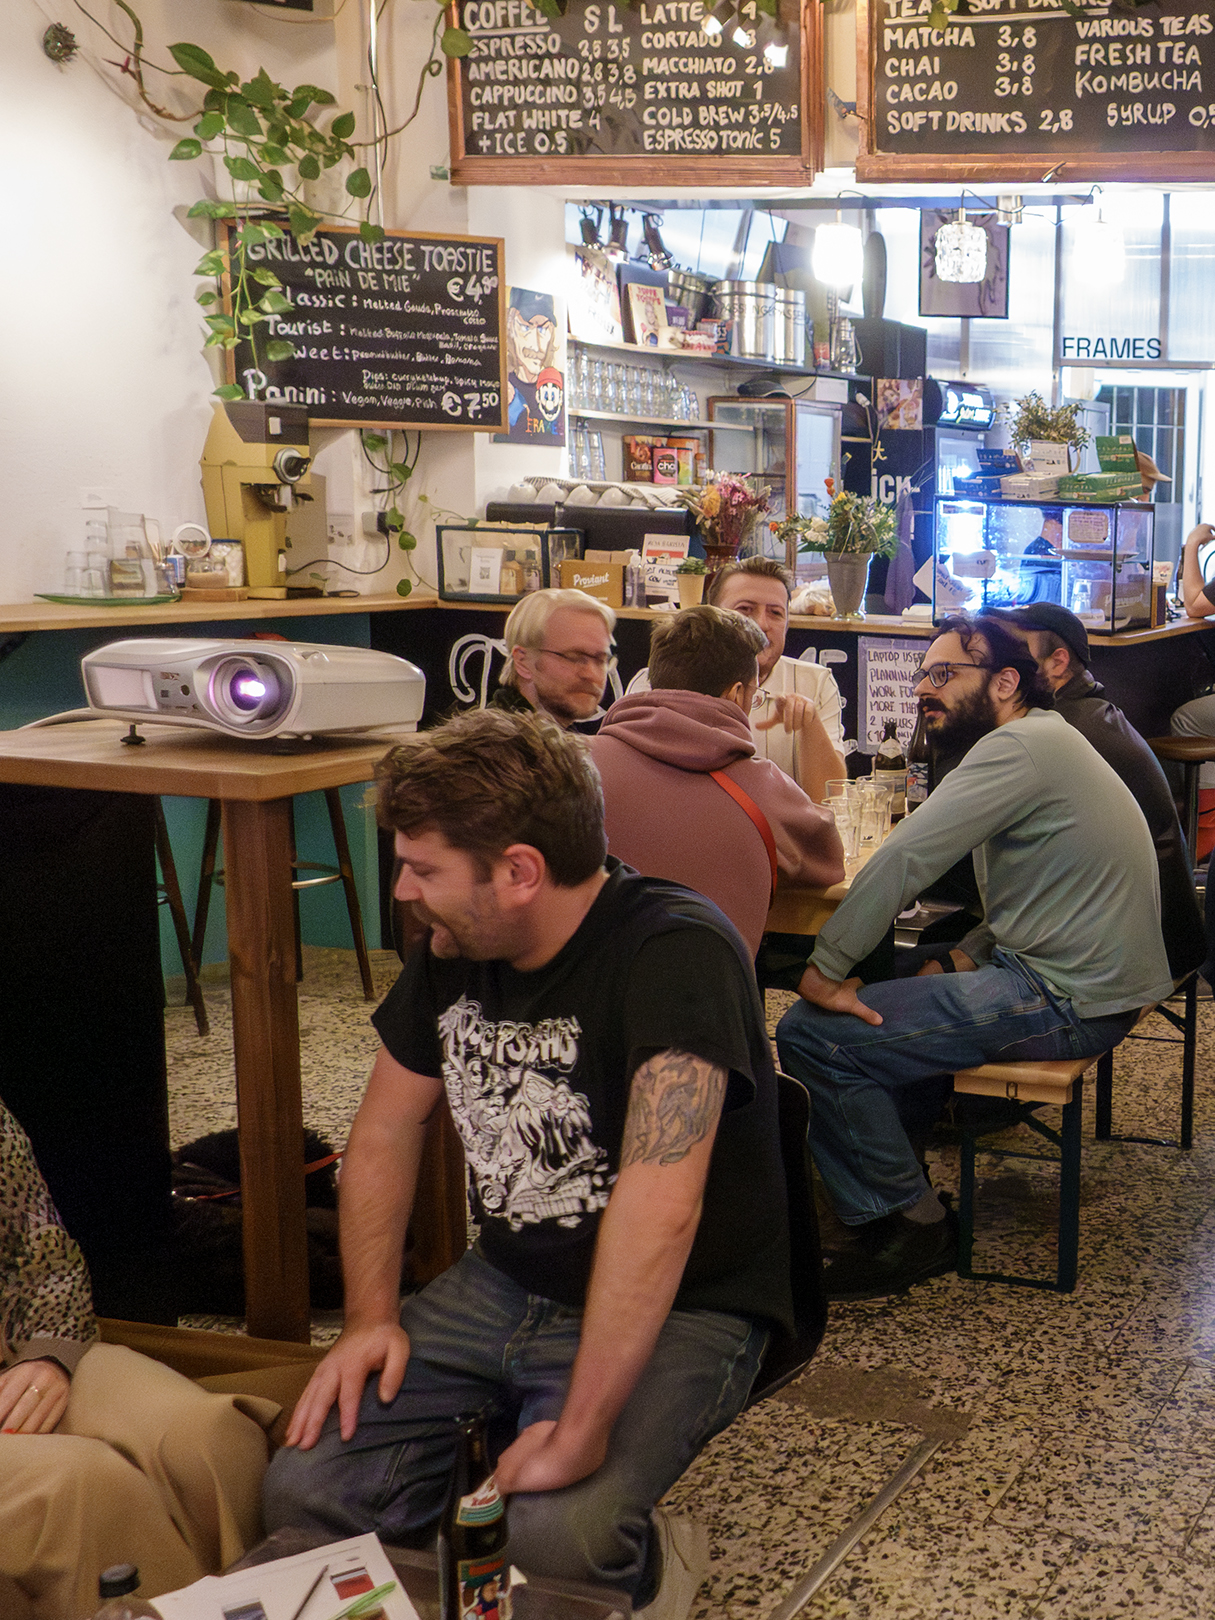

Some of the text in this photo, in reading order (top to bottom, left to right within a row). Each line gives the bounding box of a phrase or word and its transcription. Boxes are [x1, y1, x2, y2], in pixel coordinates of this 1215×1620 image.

[584, 5, 601, 33] S
[608, 5, 623, 33] L
[640, 0, 756, 25] LATTE 4
[1076, 17, 1154, 39] VARIOUS
[1159, 13, 1213, 36] TEAS
[578, 40, 602, 62] 2,5
[607, 37, 631, 62] 3,5
[641, 30, 722, 49] CORTADO
[884, 25, 1037, 51] MATCHA 3,8
[643, 55, 774, 75] MACCHIATO 2,8
[1075, 42, 1150, 66] FRESH
[1157, 41, 1202, 66] TEA
[469, 58, 580, 81] AMERICANO
[607, 63, 636, 85] 3,8
[885, 53, 1036, 78] CHAI 3,8
[644, 80, 763, 100] EXTRA SHOT 1
[886, 75, 1033, 104] CACAO 3,8
[1075, 69, 1202, 98] KOMBUCHA
[470, 84, 637, 110] CAPPUCCINO 3,5 4,5
[472, 109, 600, 131] FLAT WHITE 4
[643, 106, 693, 127] COLD
[699, 105, 745, 126] BREW
[887, 109, 1073, 134] SOFT DRINKS 2,8
[534, 130, 567, 154] 0,5
[643, 129, 718, 151] ESPRESSO
[770, 128, 782, 149] 5
[247, 235, 493, 272] GRILLED CHEESE TOASTIE
[358, 272, 379, 290] DE
[363, 298, 402, 311] Melted
[287, 342, 350, 360] weet:
[1062, 338, 1161, 359] FRAMES
[573, 572, 609, 587] Proviant
[868, 651, 899, 664] LAPTOP
[869, 685, 896, 698] WORK
[870, 701, 895, 712] MORE
[870, 716, 877, 726] 2
